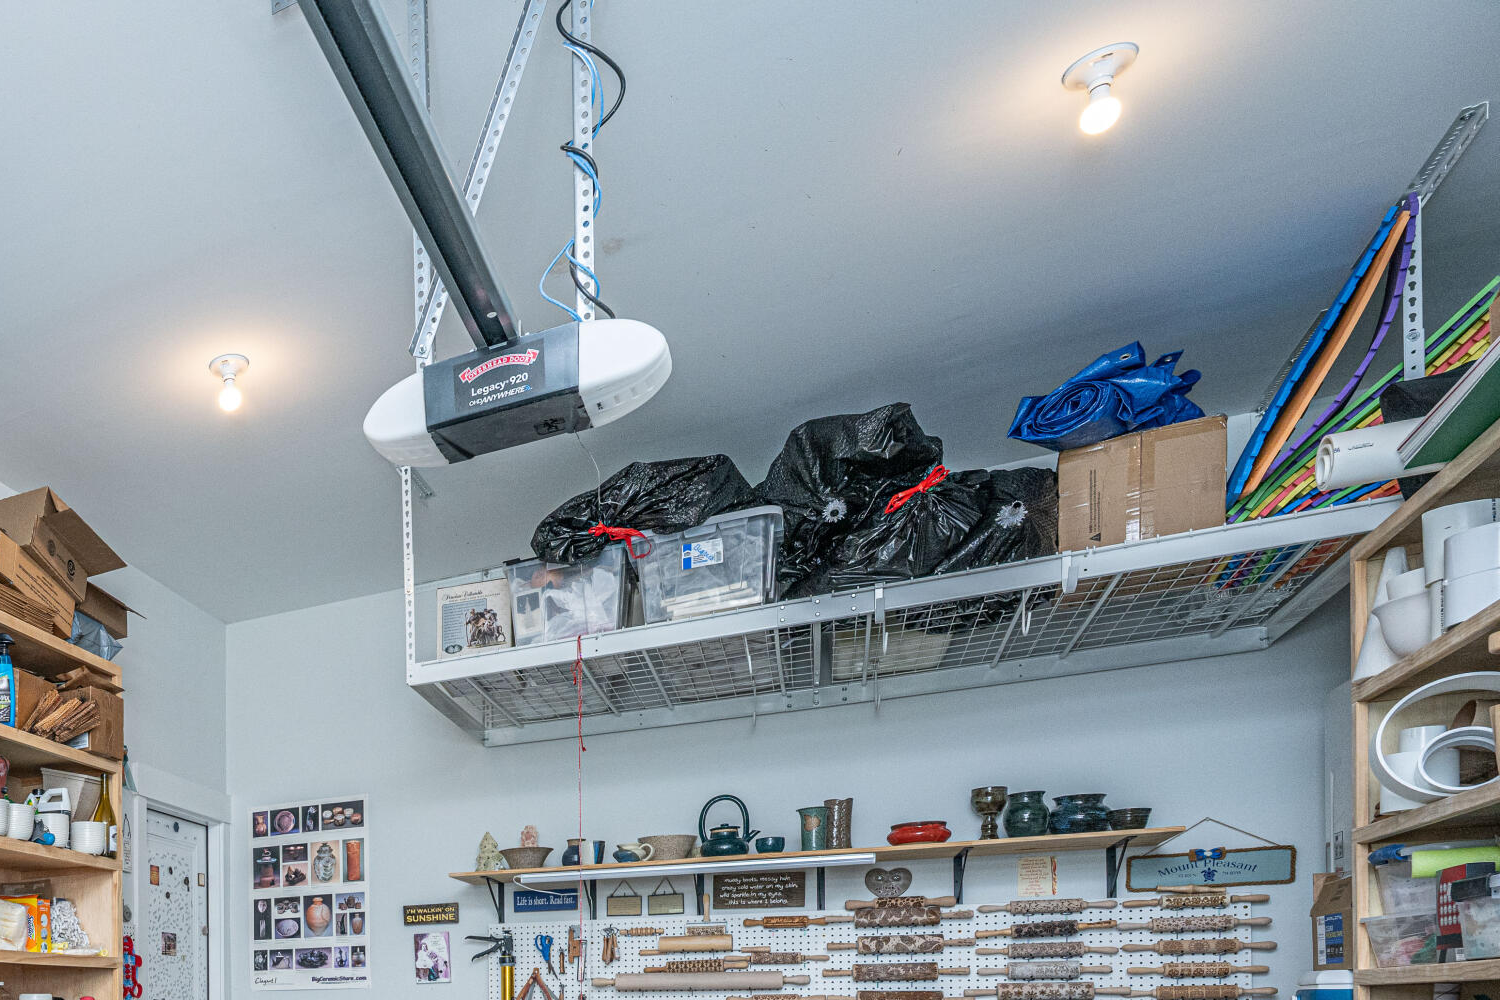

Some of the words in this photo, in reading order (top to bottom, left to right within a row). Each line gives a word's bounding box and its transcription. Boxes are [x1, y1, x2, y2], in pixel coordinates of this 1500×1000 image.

[468, 356, 507, 380] OVERHEAD
[509, 355, 531, 363] DOOR
[471, 380, 506, 397] Legacy
[509, 372, 529, 385] 920
[1157, 859, 1198, 877] Mount
[1204, 858, 1258, 873] Pleasant
[516, 896, 527, 906] Life
[528, 896, 533, 906] is
[533, 896, 549, 906] short.
[549, 895, 563, 905] Read
[731, 891, 749, 899] sparkle
[406, 913, 455, 923] SUNSHINE
